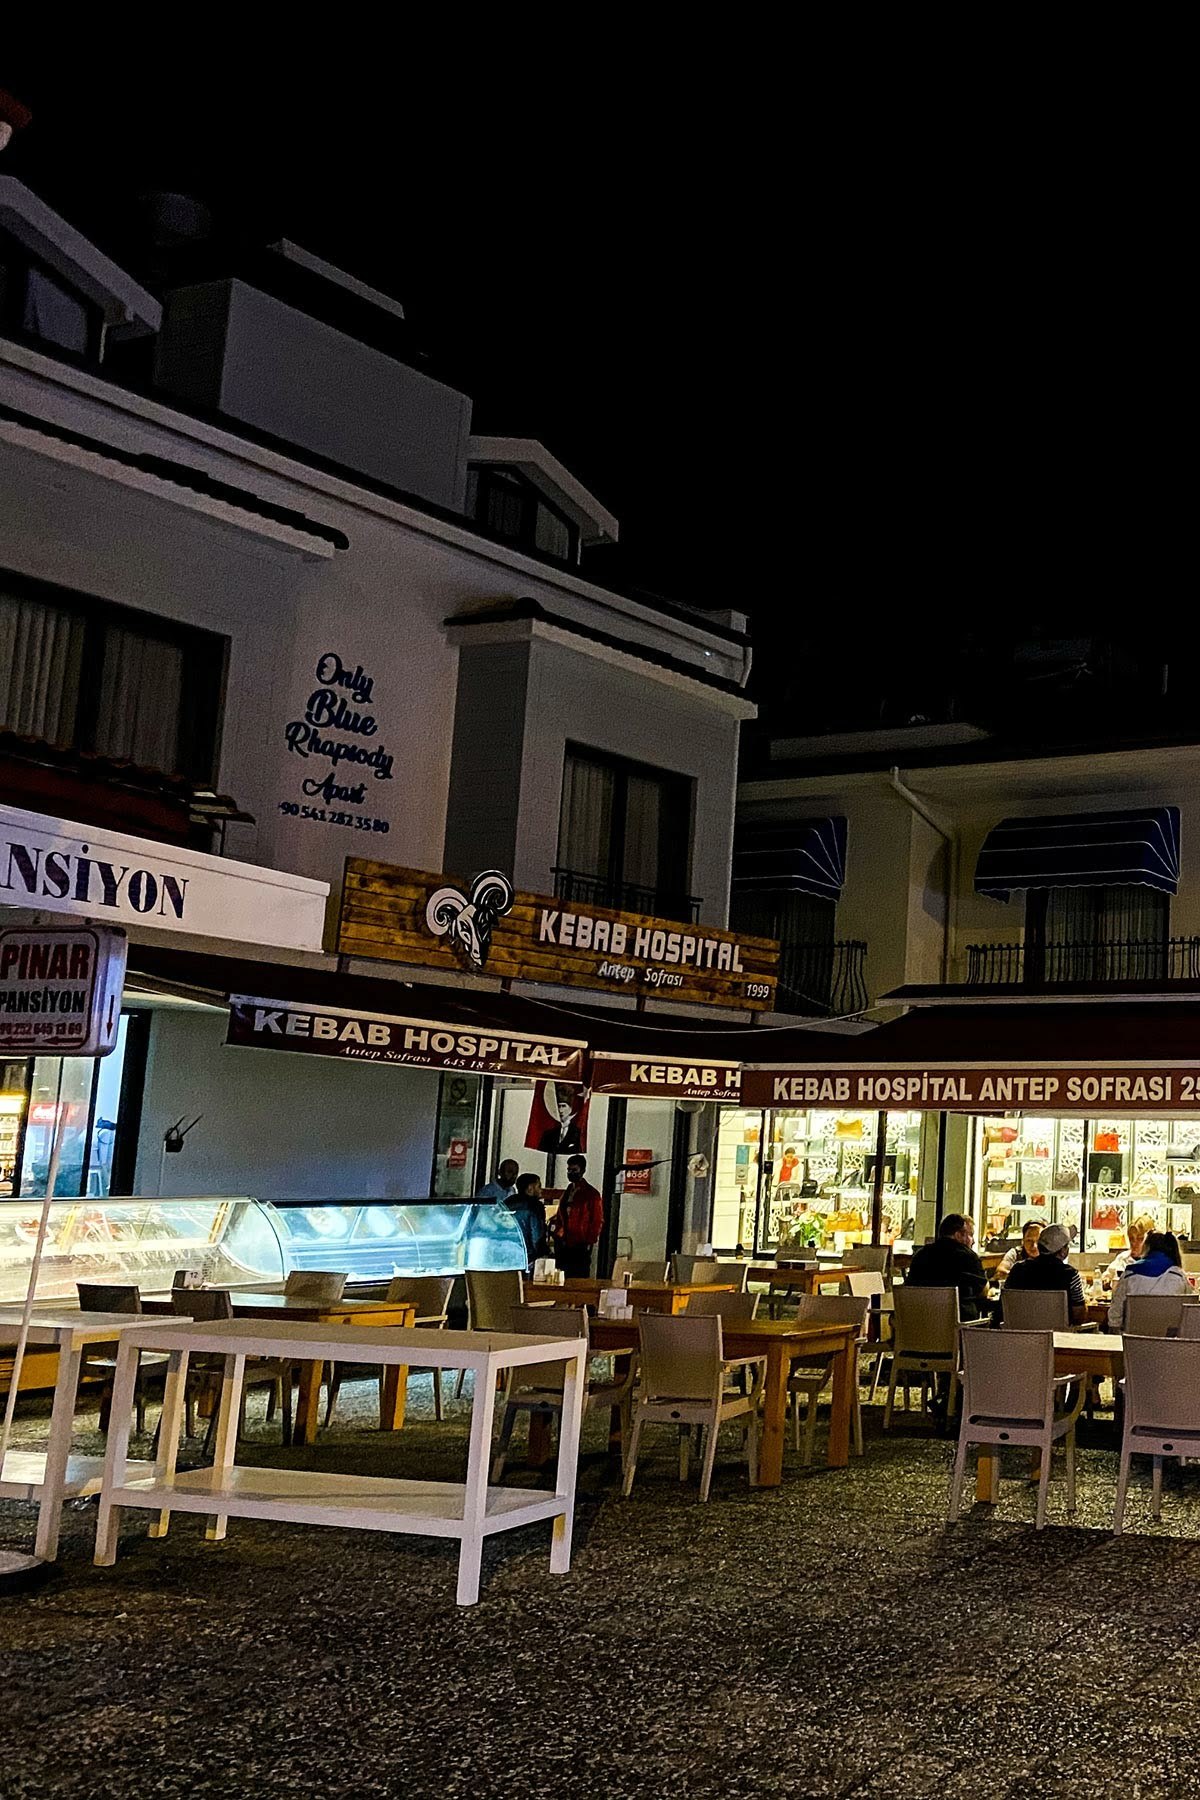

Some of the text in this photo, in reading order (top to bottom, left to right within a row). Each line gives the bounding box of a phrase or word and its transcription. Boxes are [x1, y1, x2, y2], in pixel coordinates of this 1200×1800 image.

[316, 652, 374, 703] Only
[305, 688, 378, 736] Blue
[285, 721, 394, 779] Rhapsody
[302, 772, 368, 805] Apart
[301, 805, 326, 822] 541
[329, 811, 353, 827] 282
[0, 841, 190, 919] NSİYON
[539, 909, 743, 973] KEBAB HOSPITAL
[1, 944, 90, 979] PINAR
[597, 961, 683, 988] Antep Sofrası
[746, 984, 770, 998] 1999
[253, 1009, 568, 1067] KEBAB HOSPITAL
[340, 1046, 502, 1072] Antep Sofrası 645 18 73
[630, 1064, 717, 1086] KEBAB
[683, 1088, 740, 1098] Antep Sofras
[773, 1076, 850, 1101] KEBAB
[858, 1071, 972, 1101] HOSPİTAL
[979, 1076, 1059, 1101] ANTEP
[1066, 1075, 1171, 1101] SOFRASI
